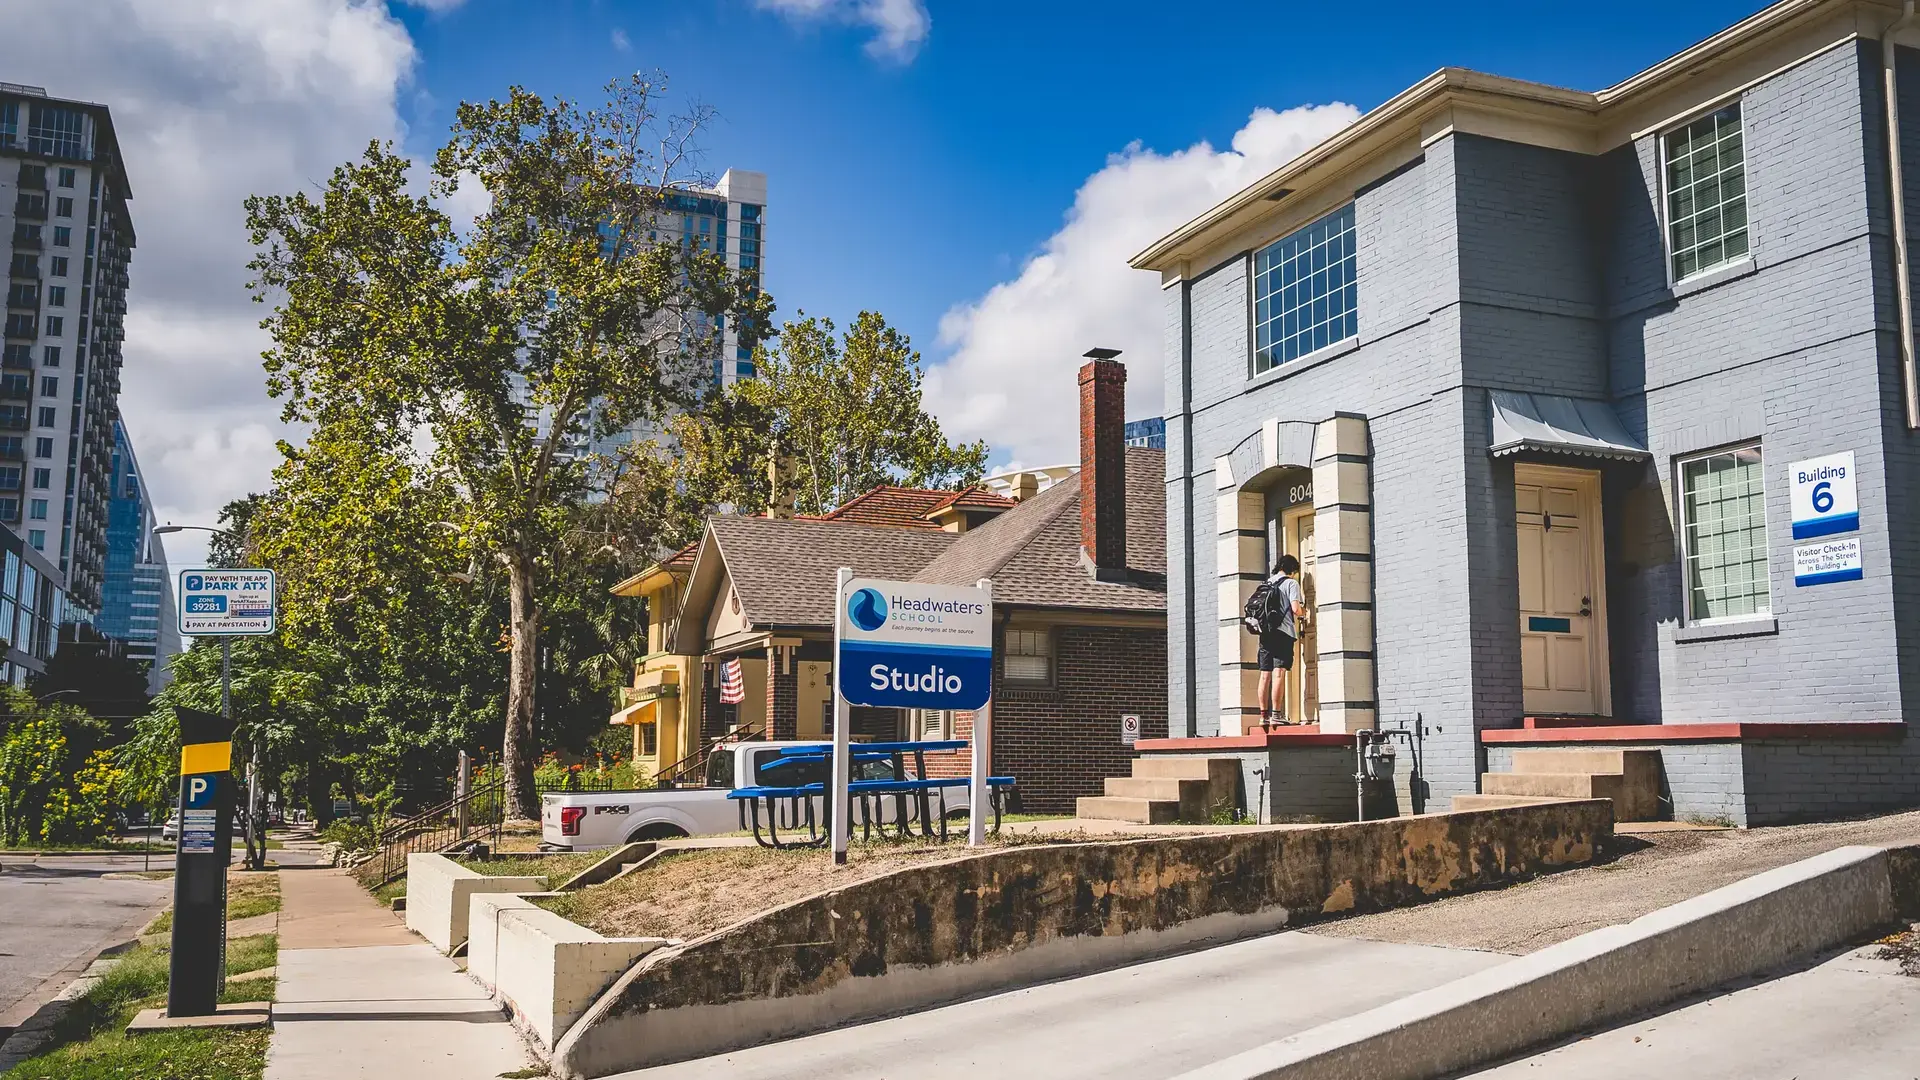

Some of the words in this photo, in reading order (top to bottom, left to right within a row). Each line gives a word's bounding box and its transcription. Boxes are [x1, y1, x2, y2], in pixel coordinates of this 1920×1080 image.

[1798, 466, 1846, 484] Building
[1290, 482, 1313, 503] 804
[1812, 482, 1834, 513] 6
[1797, 548, 1821, 557] Visitor
[1823, 542, 1857, 554] Check-In
[1797, 557, 1820, 565] Across
[1835, 552, 1857, 560] Street
[1815, 562, 1841, 571] Building
[205, 582, 239, 590] PARK
[243, 582, 267, 590] ATX
[192, 602, 221, 611] 39281
[892, 595, 983, 615] Headwaters
[892, 612, 943, 623] SCHOOL
[870, 663, 962, 694] Studio
[190, 778, 207, 802] P
